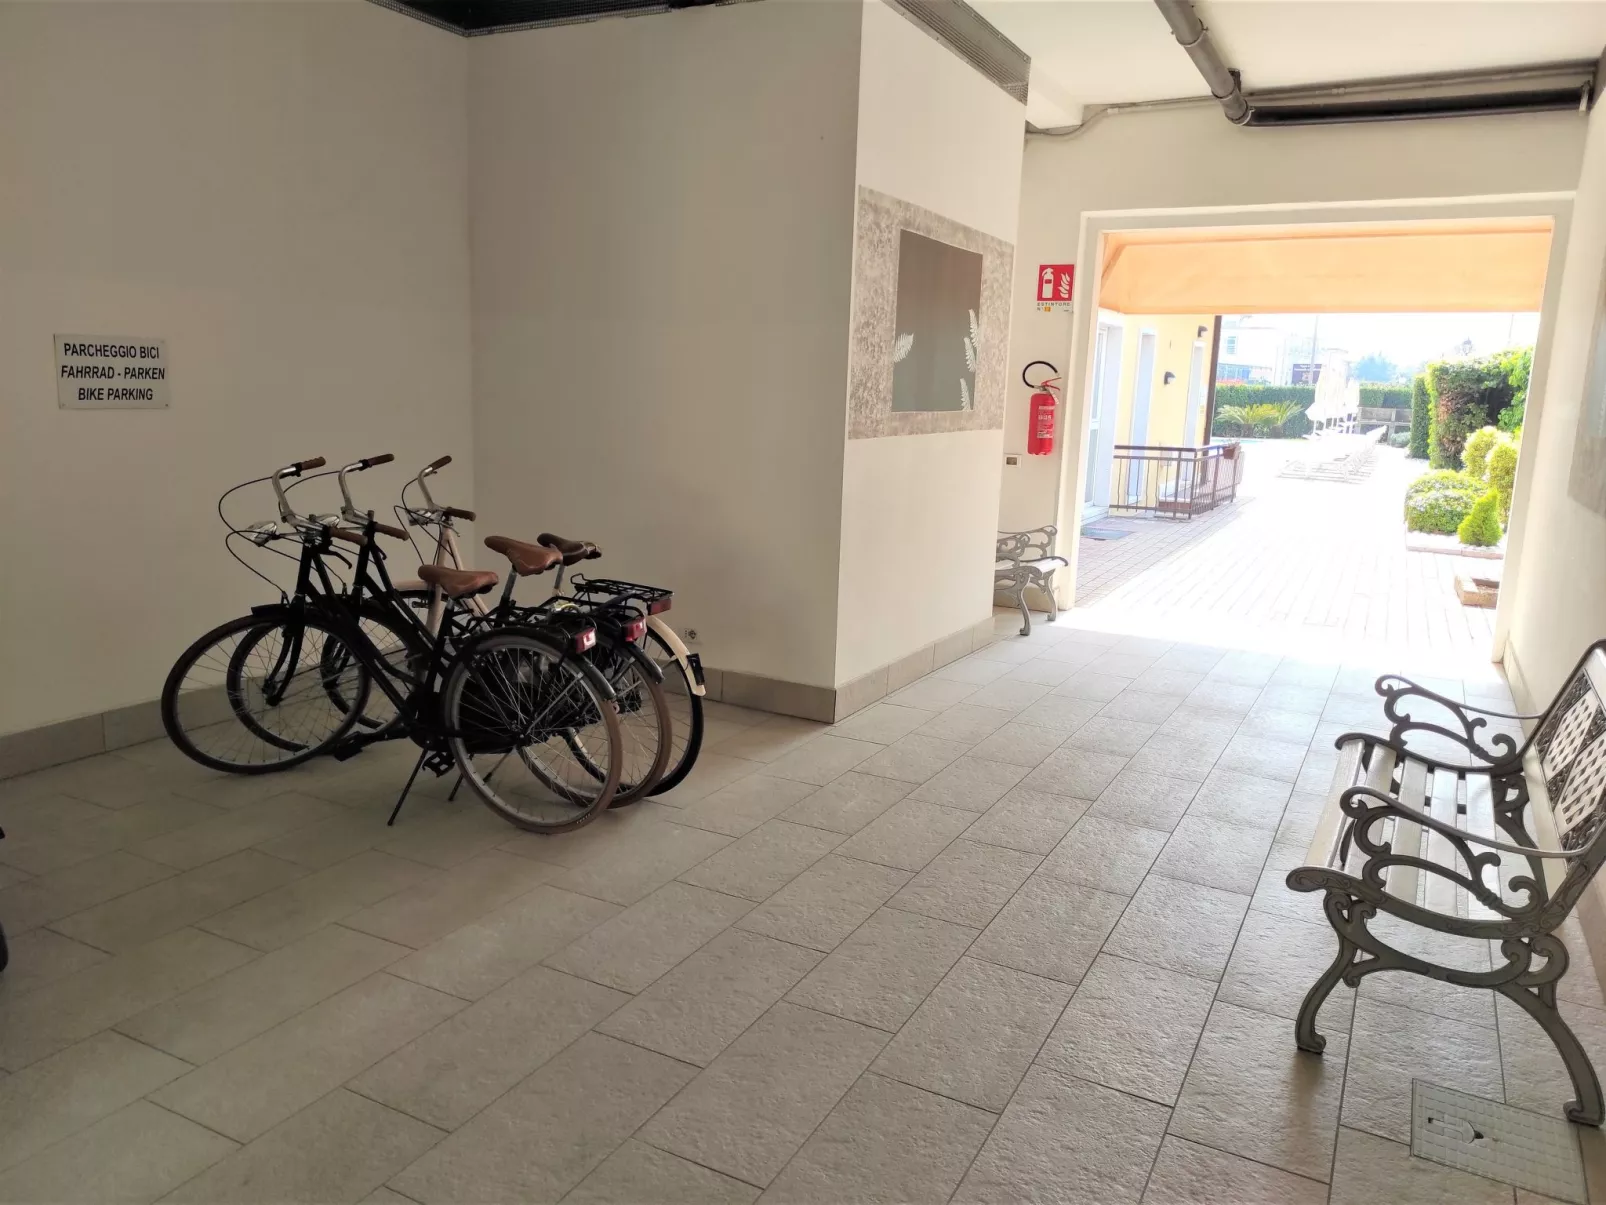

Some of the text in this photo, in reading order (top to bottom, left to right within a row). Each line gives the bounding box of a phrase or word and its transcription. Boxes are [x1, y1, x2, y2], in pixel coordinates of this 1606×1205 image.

[63, 342, 160, 359] PARCHEGGIO BICI
[61, 365, 115, 379] FAHRRAD
[124, 367, 165, 380] PARKEN
[78, 387, 153, 401] BIKE PARKING
